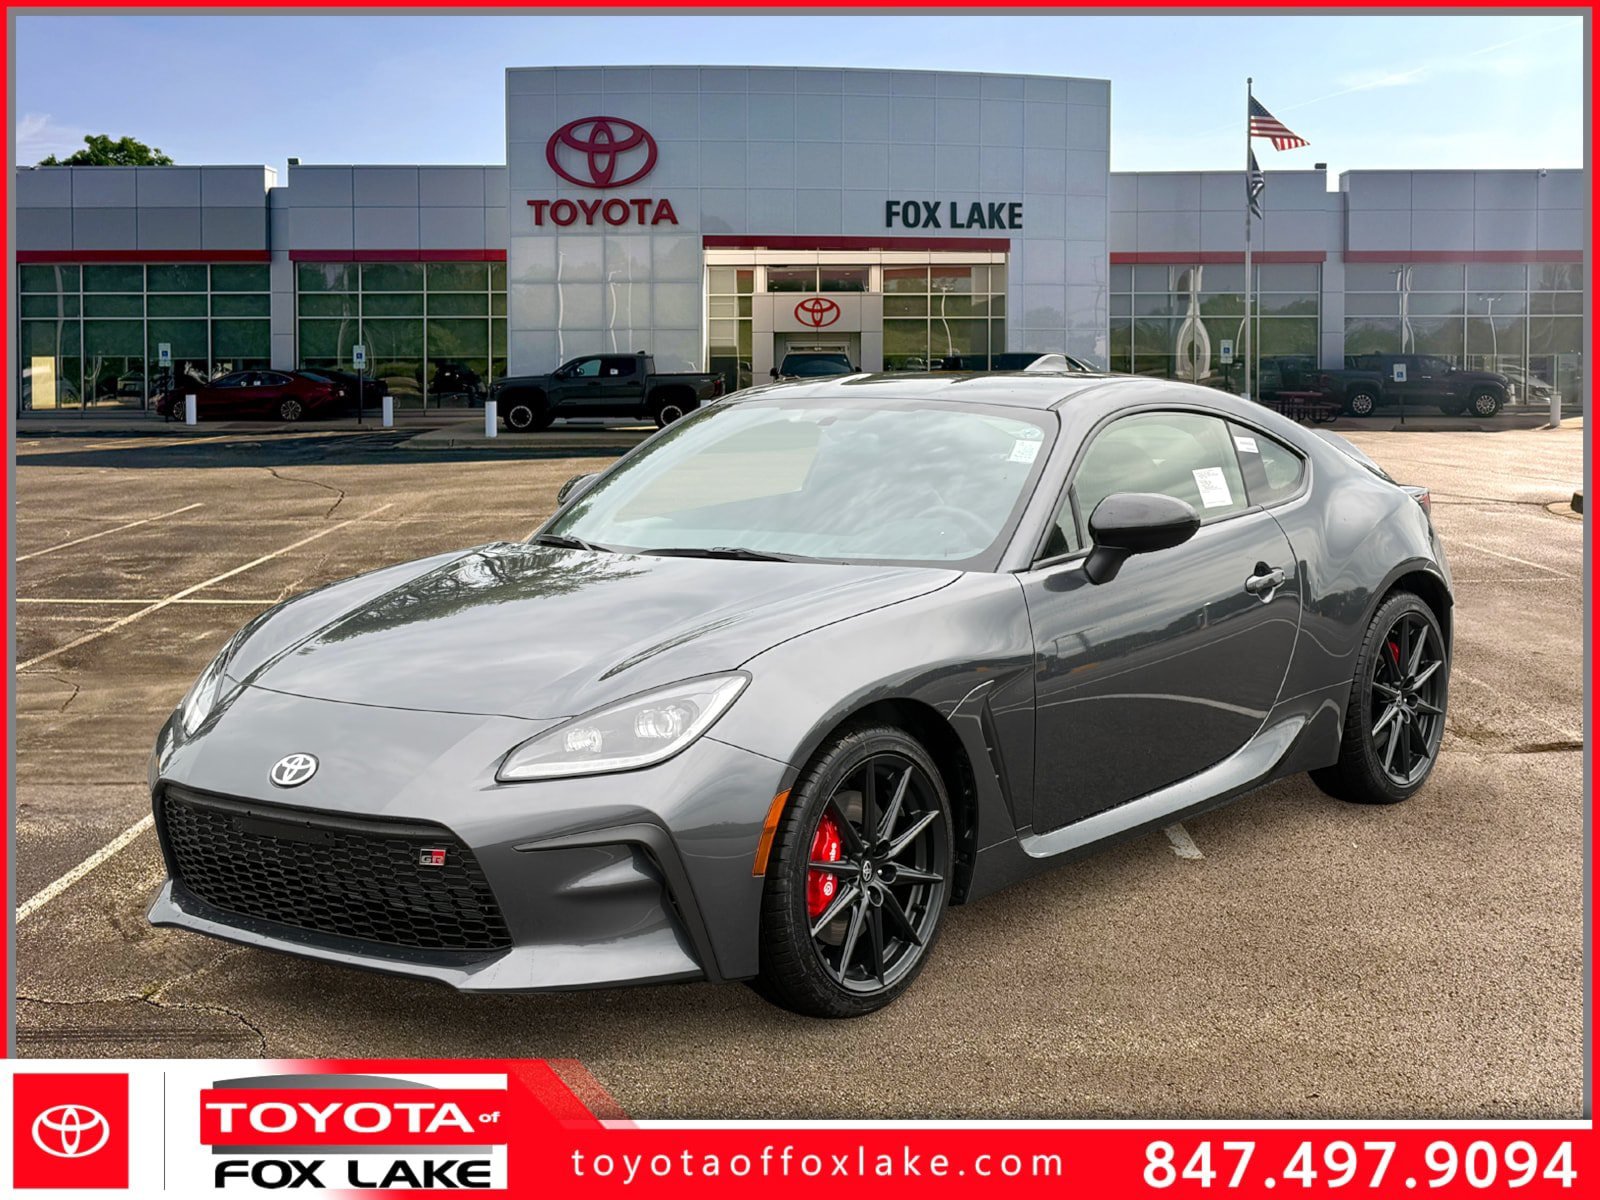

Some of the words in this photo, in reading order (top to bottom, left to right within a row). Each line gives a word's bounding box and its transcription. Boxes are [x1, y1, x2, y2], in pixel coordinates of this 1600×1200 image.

[527, 199, 679, 226] TOYOTA
[885, 200, 942, 229] FOX
[950, 201, 1023, 230] LAKE
